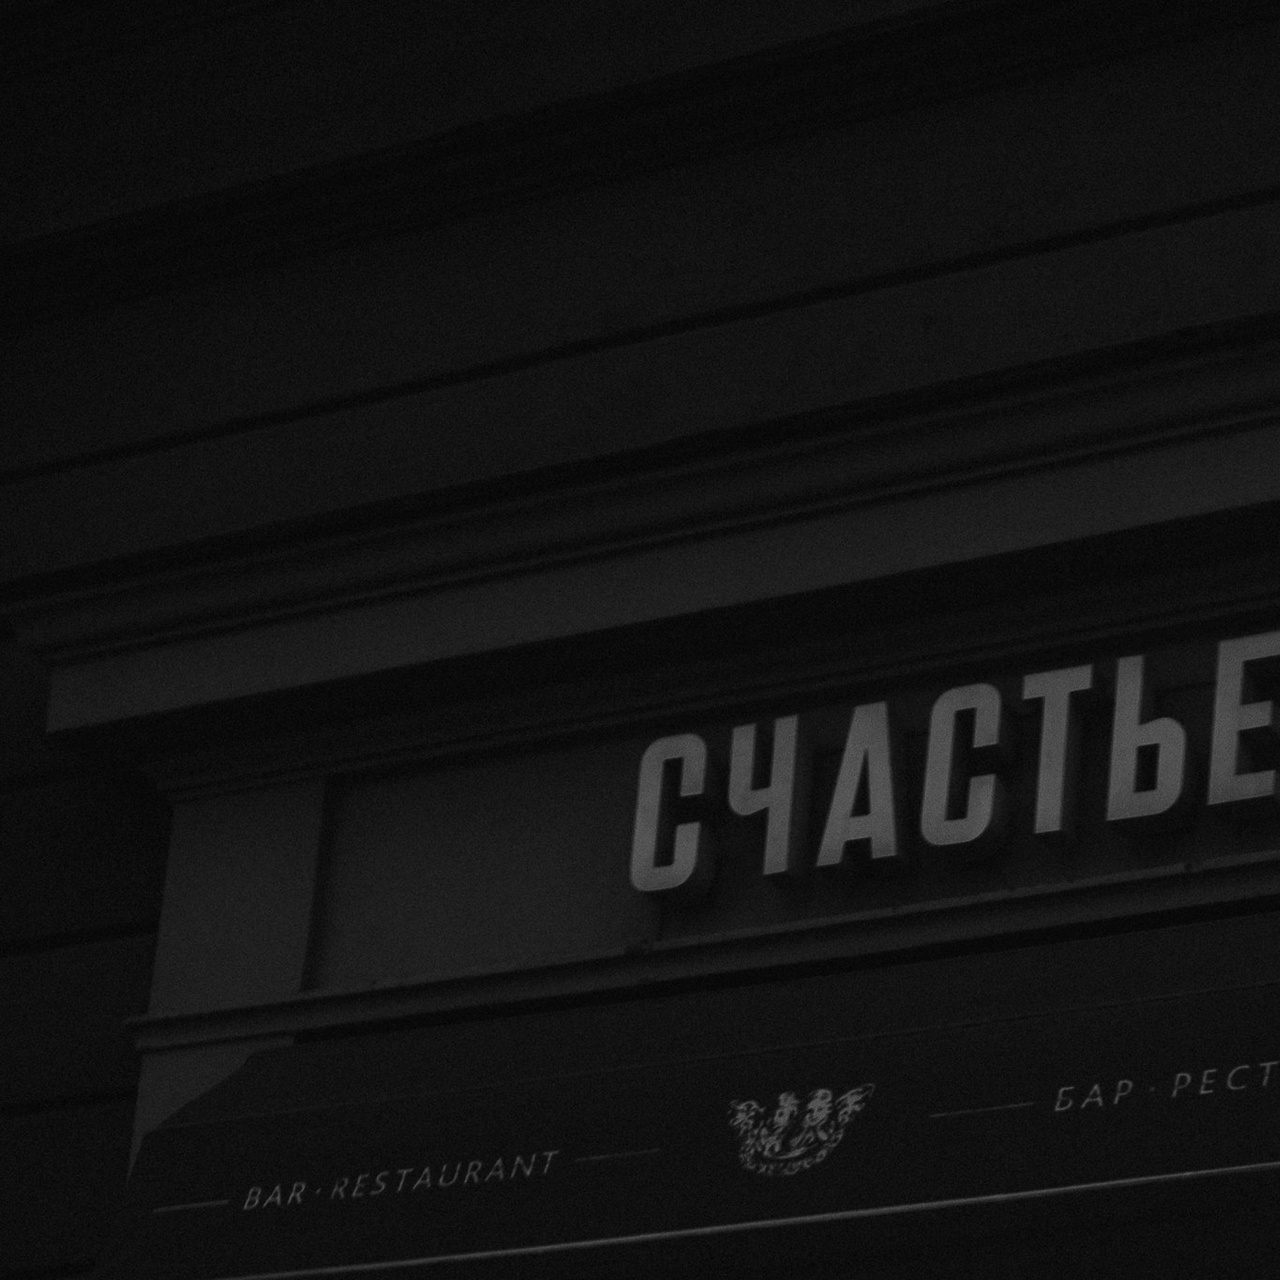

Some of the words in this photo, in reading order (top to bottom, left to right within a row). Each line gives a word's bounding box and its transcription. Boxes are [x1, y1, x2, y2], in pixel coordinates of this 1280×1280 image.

[1053, 1078, 1134, 1112] БАР
[242, 1180, 307, 1211] BAR
[331, 1149, 561, 1199] RESTAURANT
